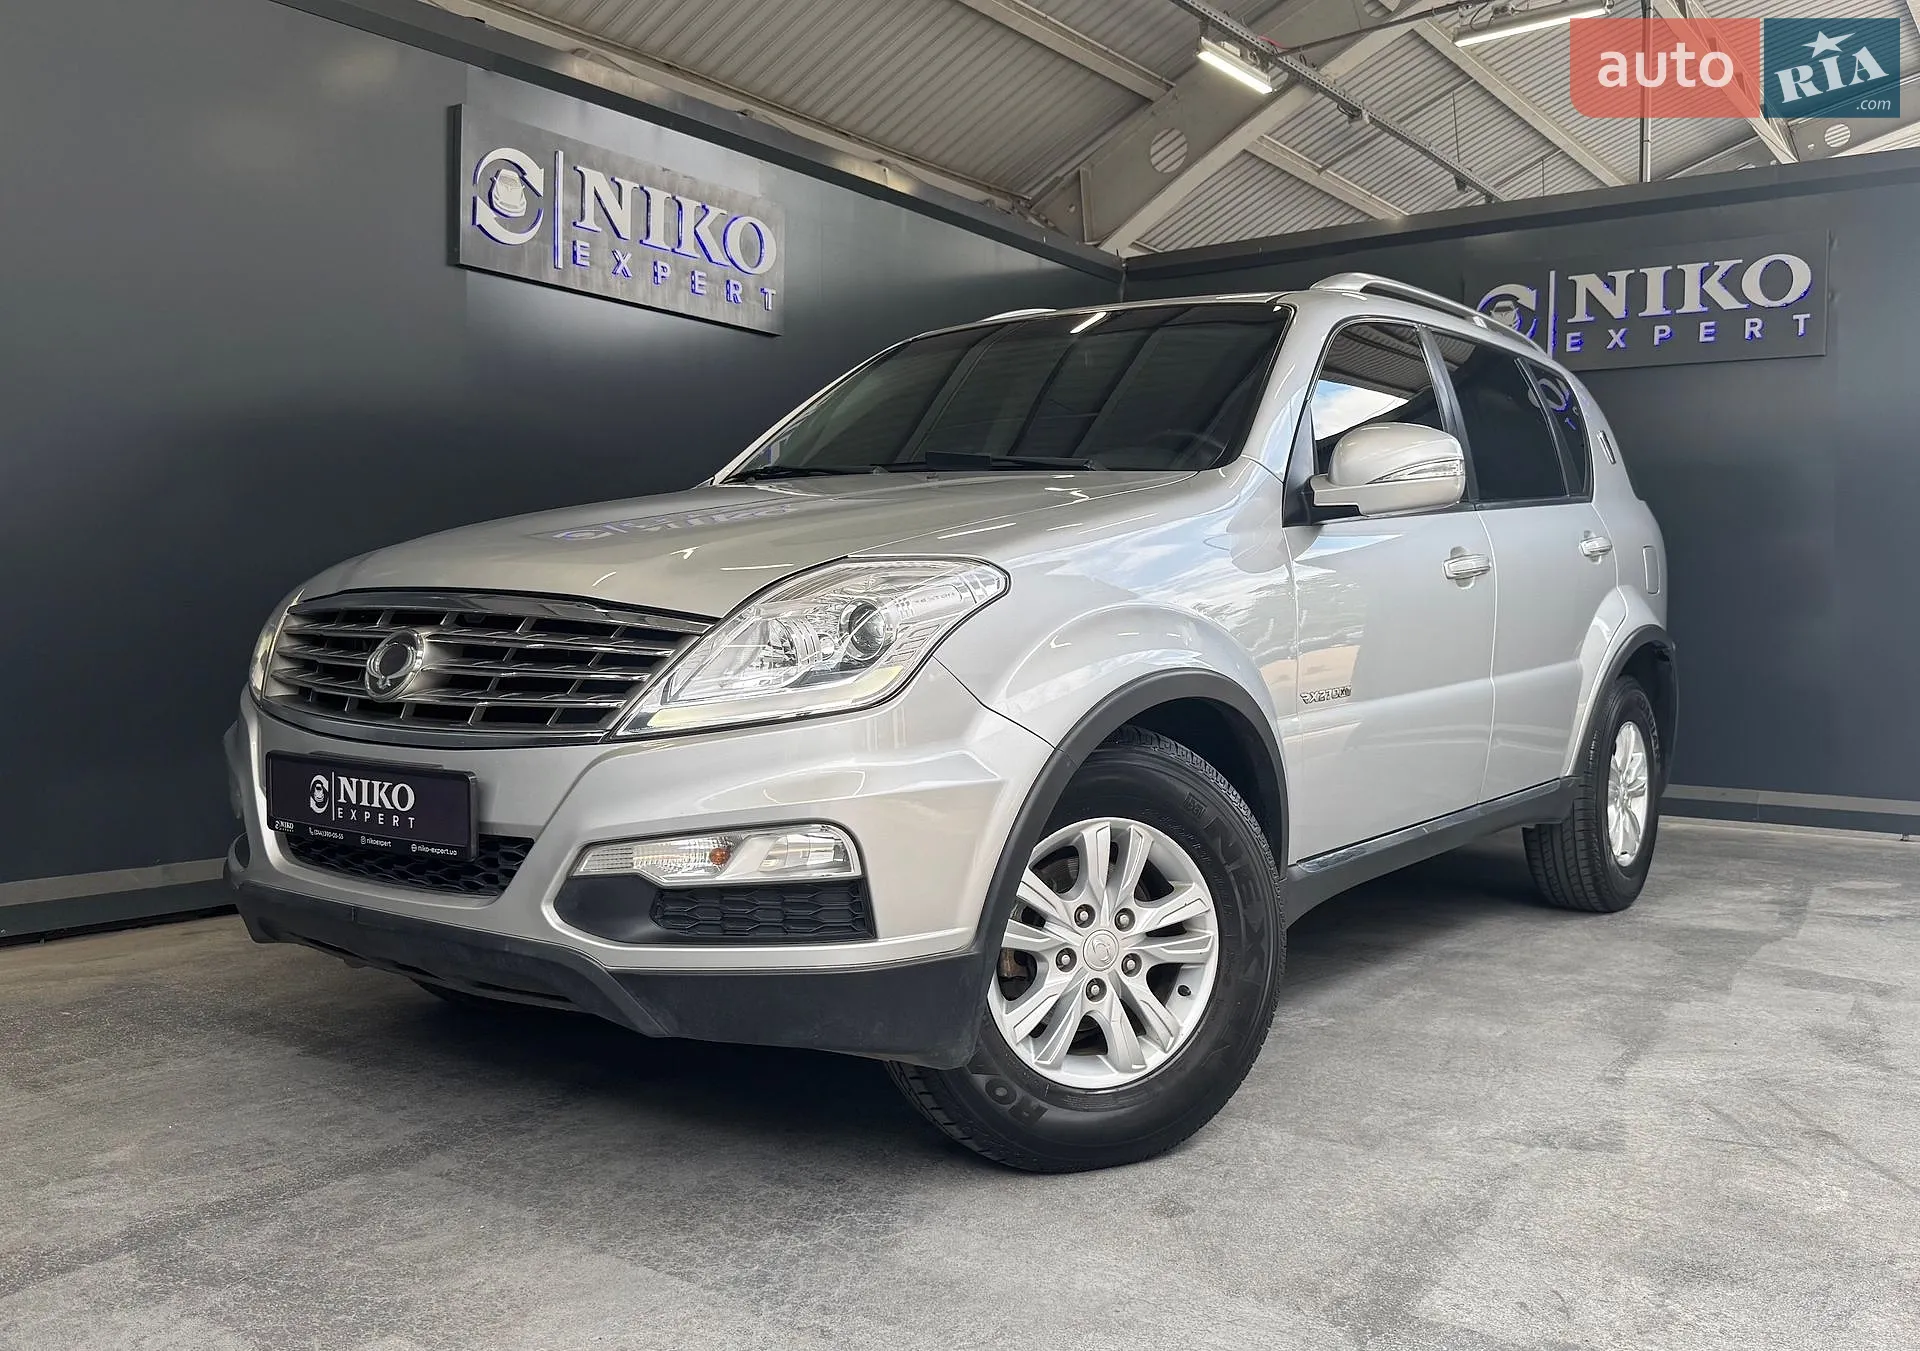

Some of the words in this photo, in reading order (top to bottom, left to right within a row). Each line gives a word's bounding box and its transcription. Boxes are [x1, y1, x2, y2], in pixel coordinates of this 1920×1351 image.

[572, 165, 777, 275] NIKO
[572, 240, 777, 311] EXPERT
[1566, 253, 1812, 322] NIKO
[1566, 313, 1811, 353] EXPERT
[337, 776, 415, 812] NIKO
[338, 807, 416, 829] EXPERT
